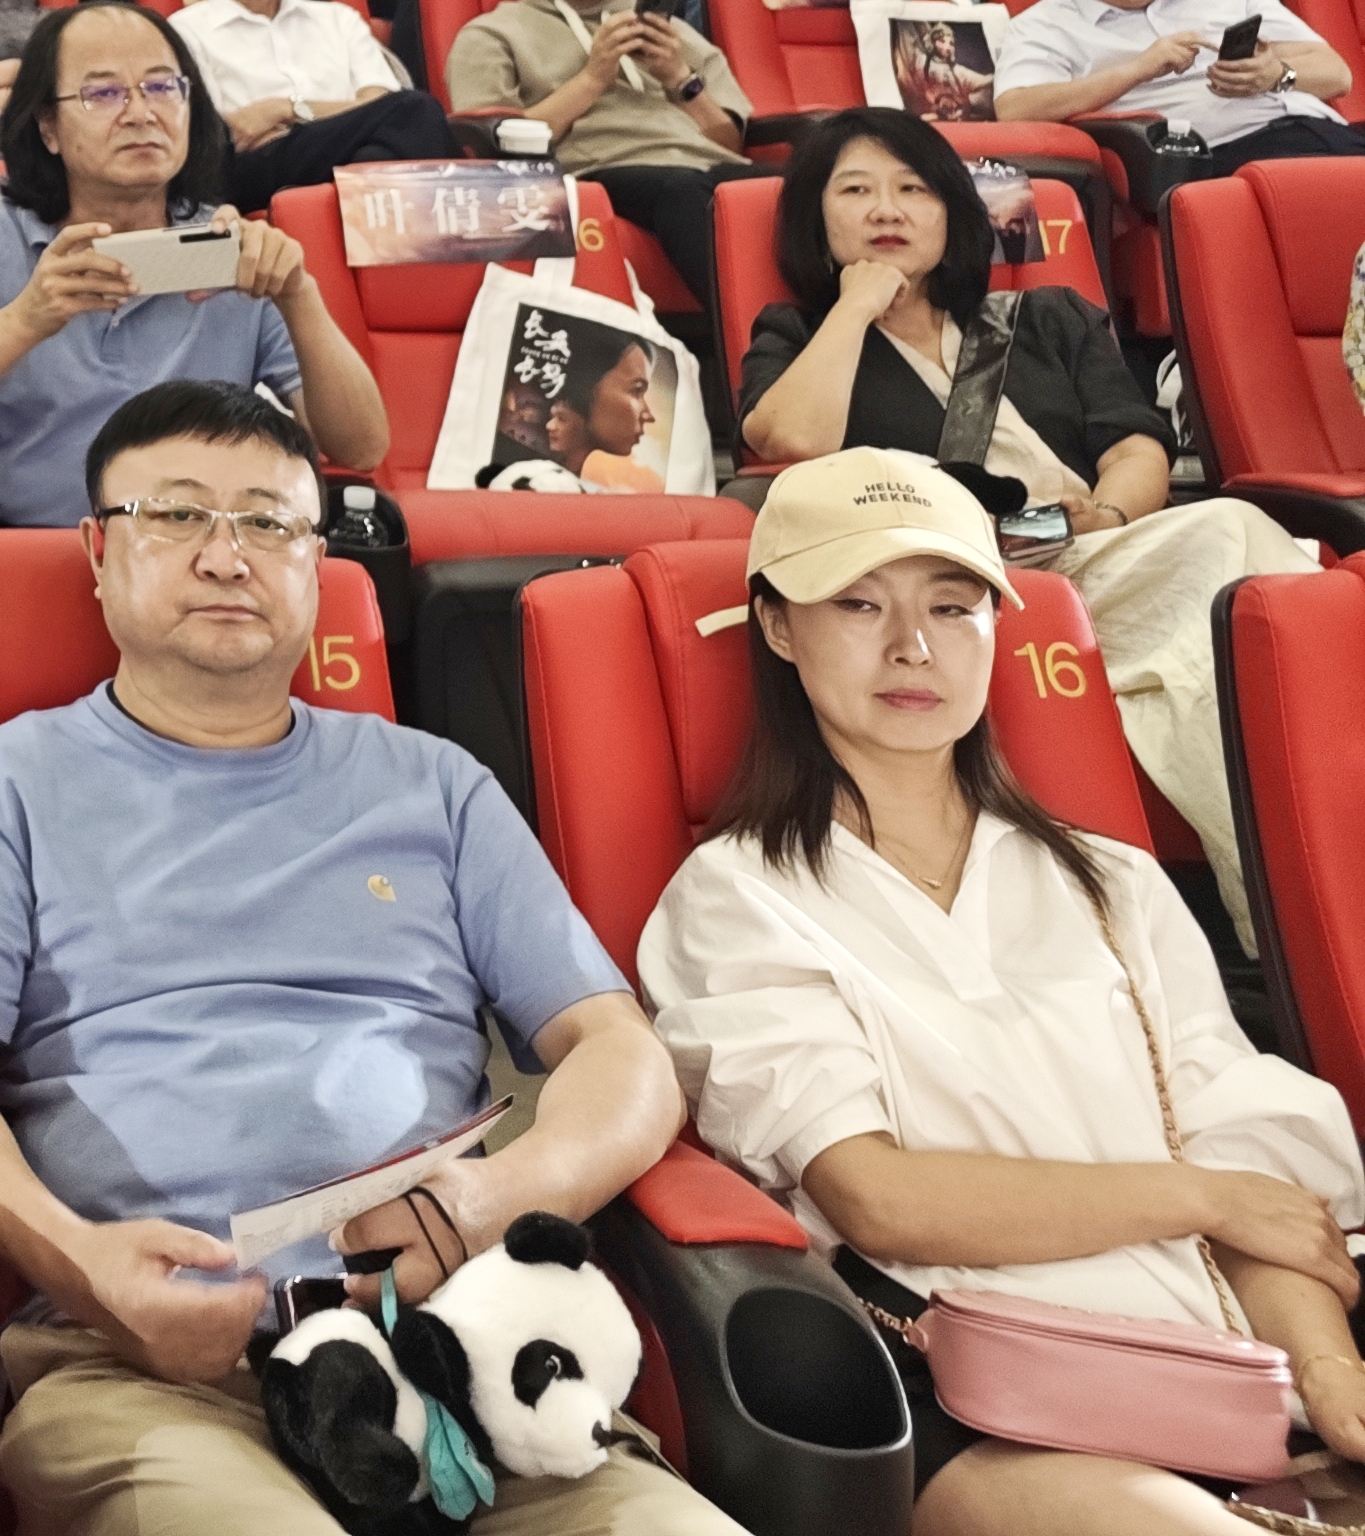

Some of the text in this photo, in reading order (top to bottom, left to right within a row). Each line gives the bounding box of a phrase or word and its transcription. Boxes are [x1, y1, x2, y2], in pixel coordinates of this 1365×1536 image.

[363, 185, 553, 235] 叶倩雯
[1037, 218, 1073, 256] 17
[852, 492, 932, 508] WEEKEND
[864, 481, 915, 494] HELLO
[308, 635, 362, 692] 15
[1013, 641, 1088, 699] 16
